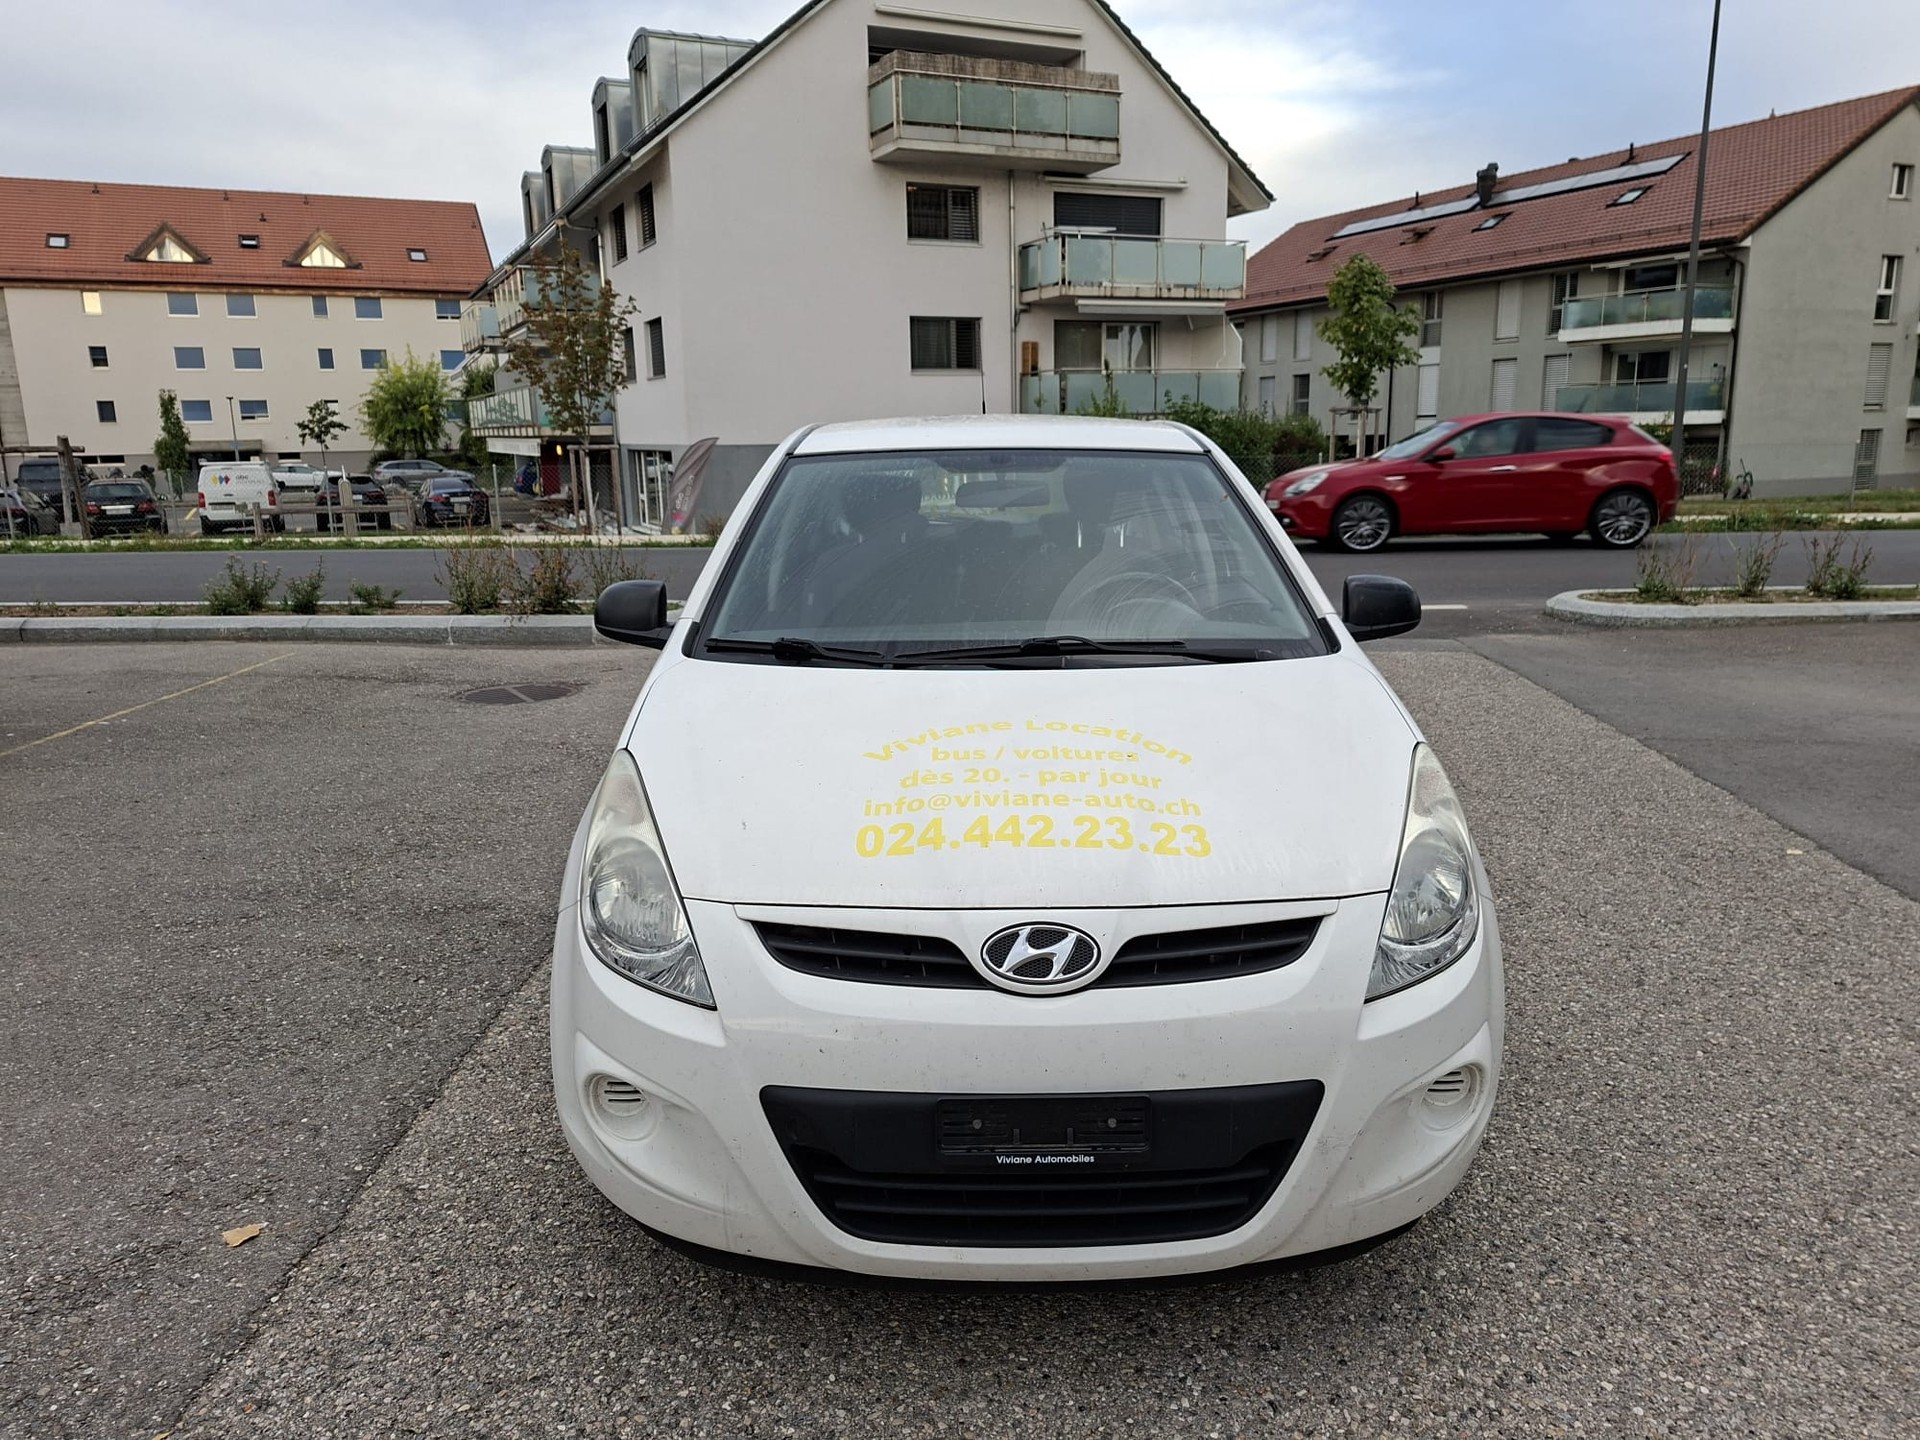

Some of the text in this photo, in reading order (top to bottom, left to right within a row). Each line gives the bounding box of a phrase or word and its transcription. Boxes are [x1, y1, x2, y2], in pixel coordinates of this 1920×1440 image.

[862, 719, 1193, 765] Viviane Location
[931, 747, 987, 763] bus
[1013, 745, 1140, 763] voitures
[899, 768, 954, 790] dès
[1038, 769, 1091, 788] par
[1098, 768, 1162, 790] jour
[863, 790, 1202, 817] info@viviane-auto.ch
[855, 814, 1213, 859] 024.442.23.23
[996, 1154, 1095, 1164] Viviane Automobiles
